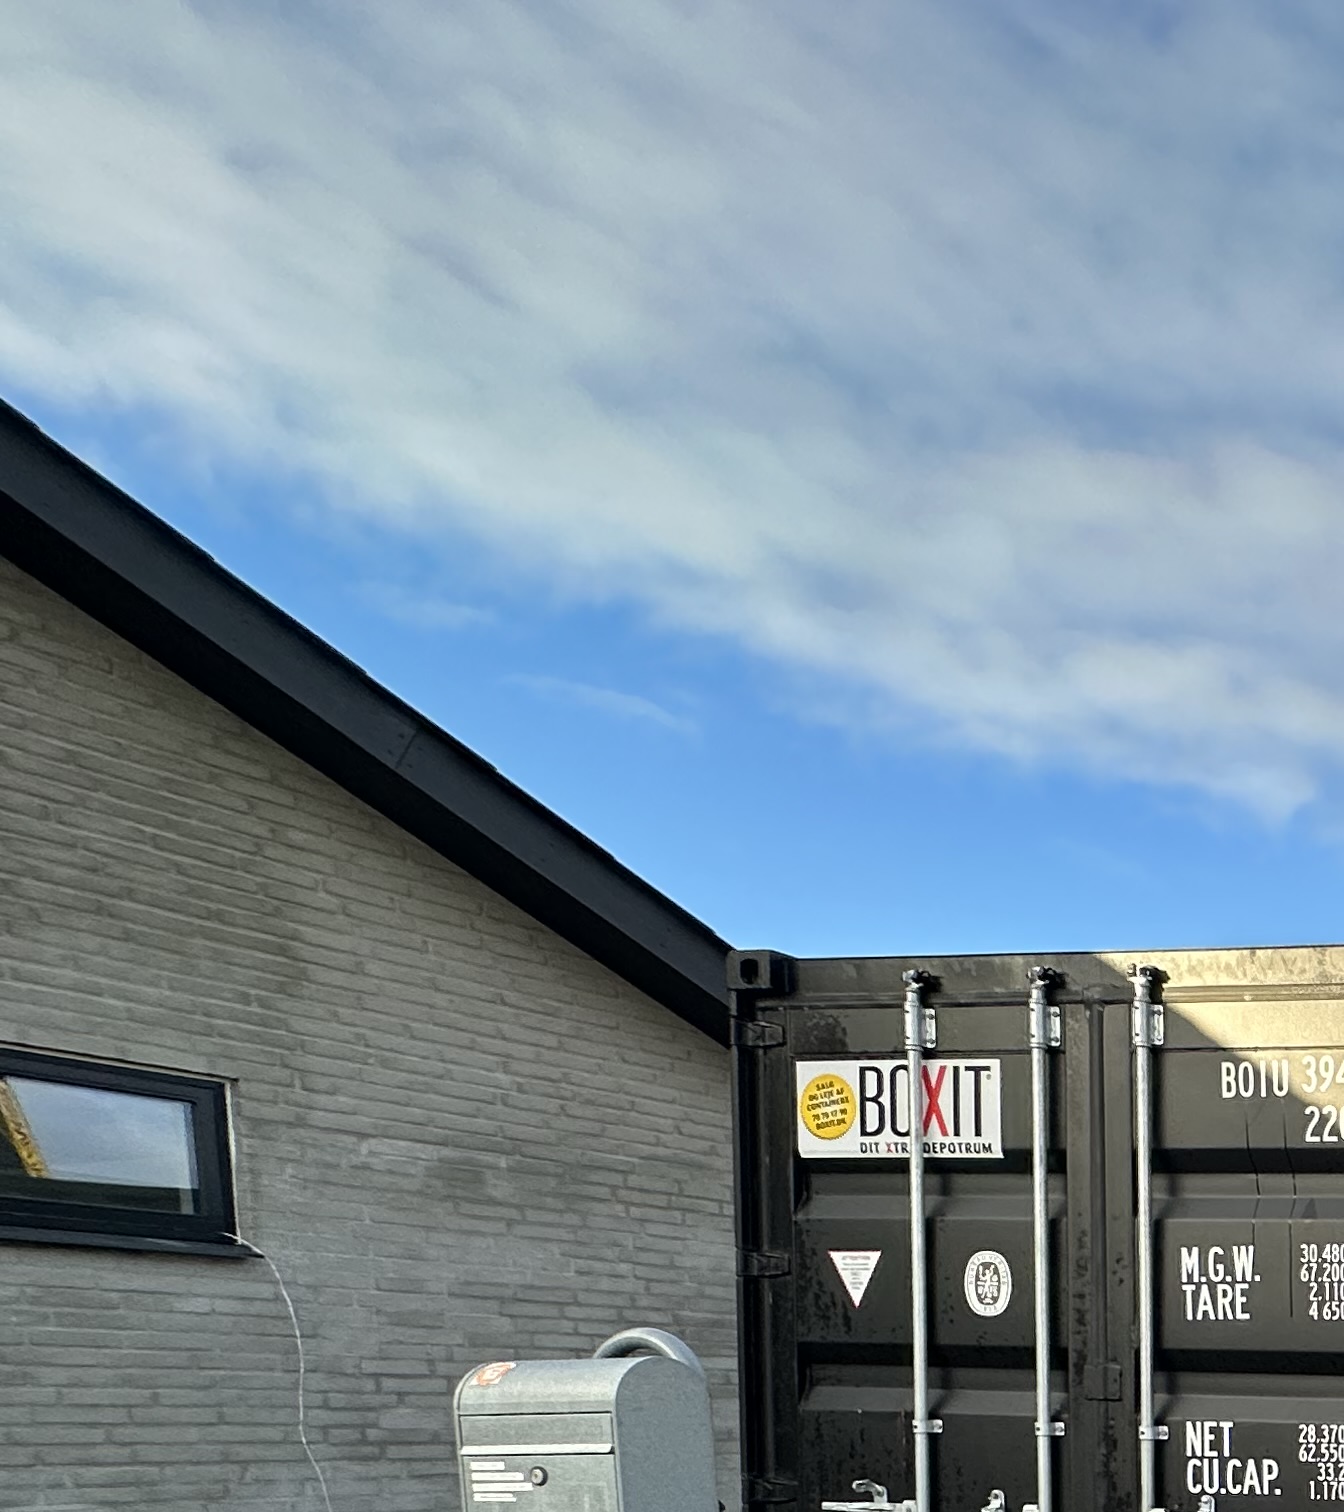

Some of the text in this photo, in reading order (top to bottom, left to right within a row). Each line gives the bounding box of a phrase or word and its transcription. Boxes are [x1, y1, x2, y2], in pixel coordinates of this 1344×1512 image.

[860, 1142, 993, 1154] DIT XTR DEPOTRUM
[1180, 1245, 1261, 1283] M.G.W.
[1181, 1283, 1250, 1321] TARE
[1185, 1421, 1234, 1457] NET
[1186, 1458, 1282, 1495] CU.CAP.
